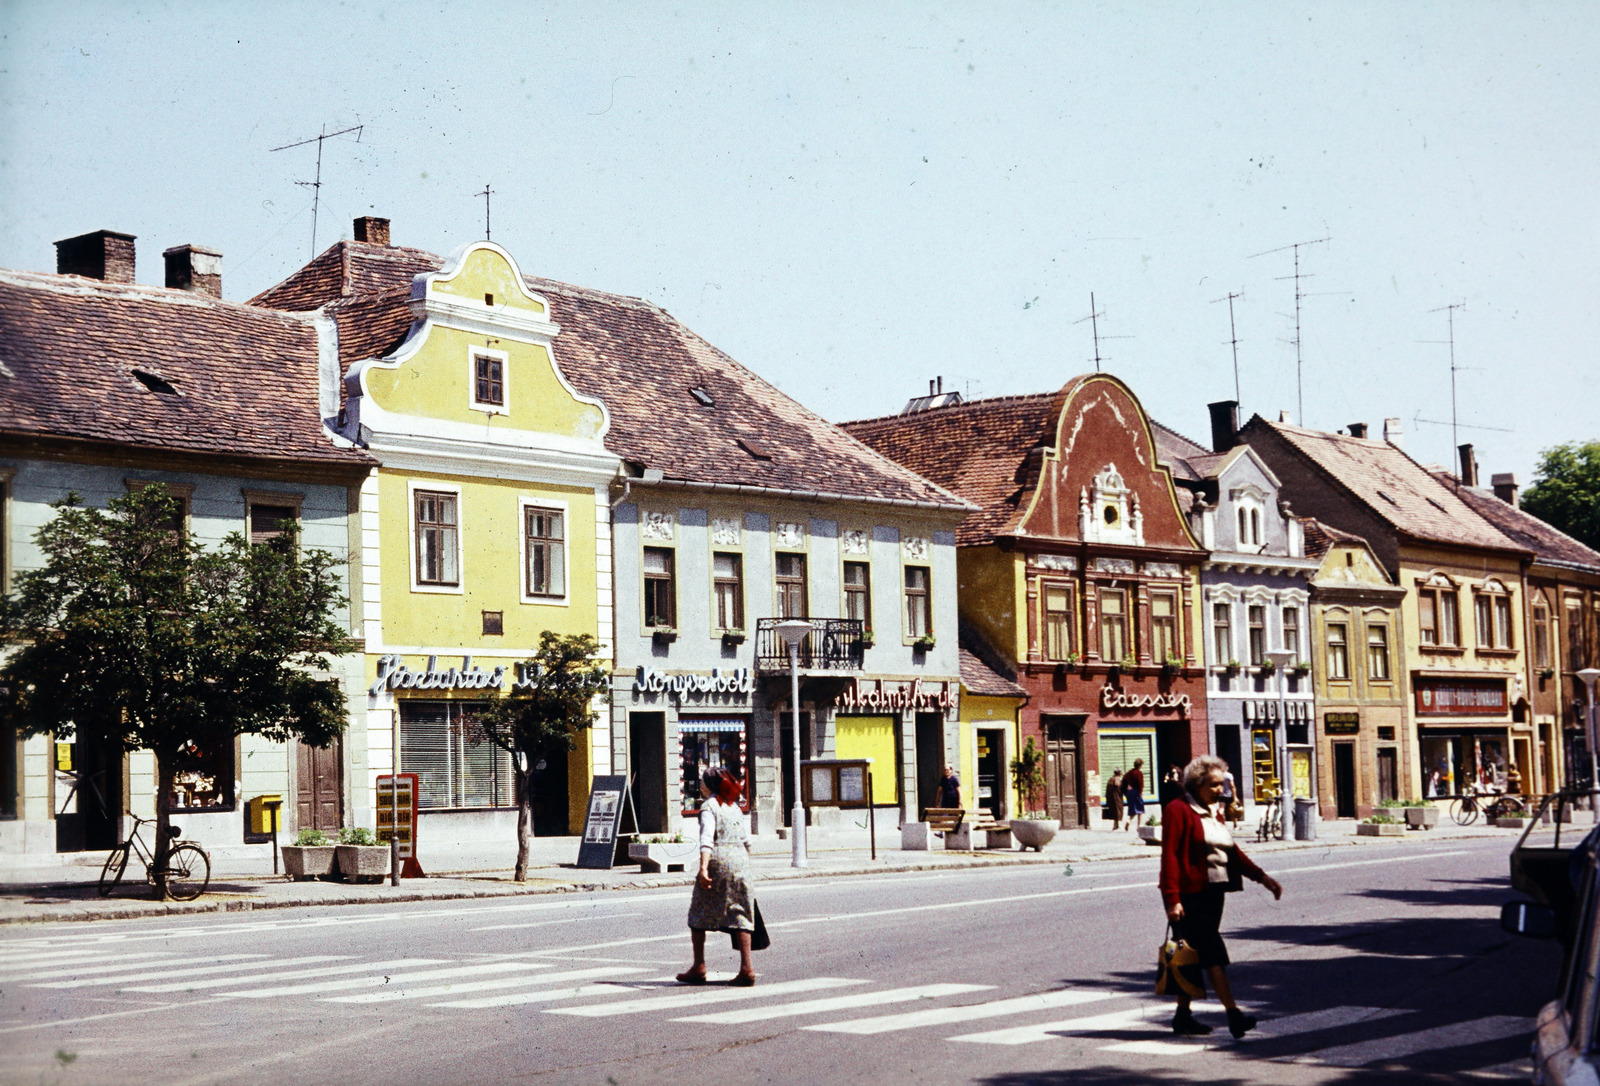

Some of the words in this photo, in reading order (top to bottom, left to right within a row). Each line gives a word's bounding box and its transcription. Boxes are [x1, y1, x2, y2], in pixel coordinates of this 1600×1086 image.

[911, 677, 960, 707] Áruk
[379, 795, 410, 805] SOUNIR
[379, 811, 410, 823] AJÁDÉK
